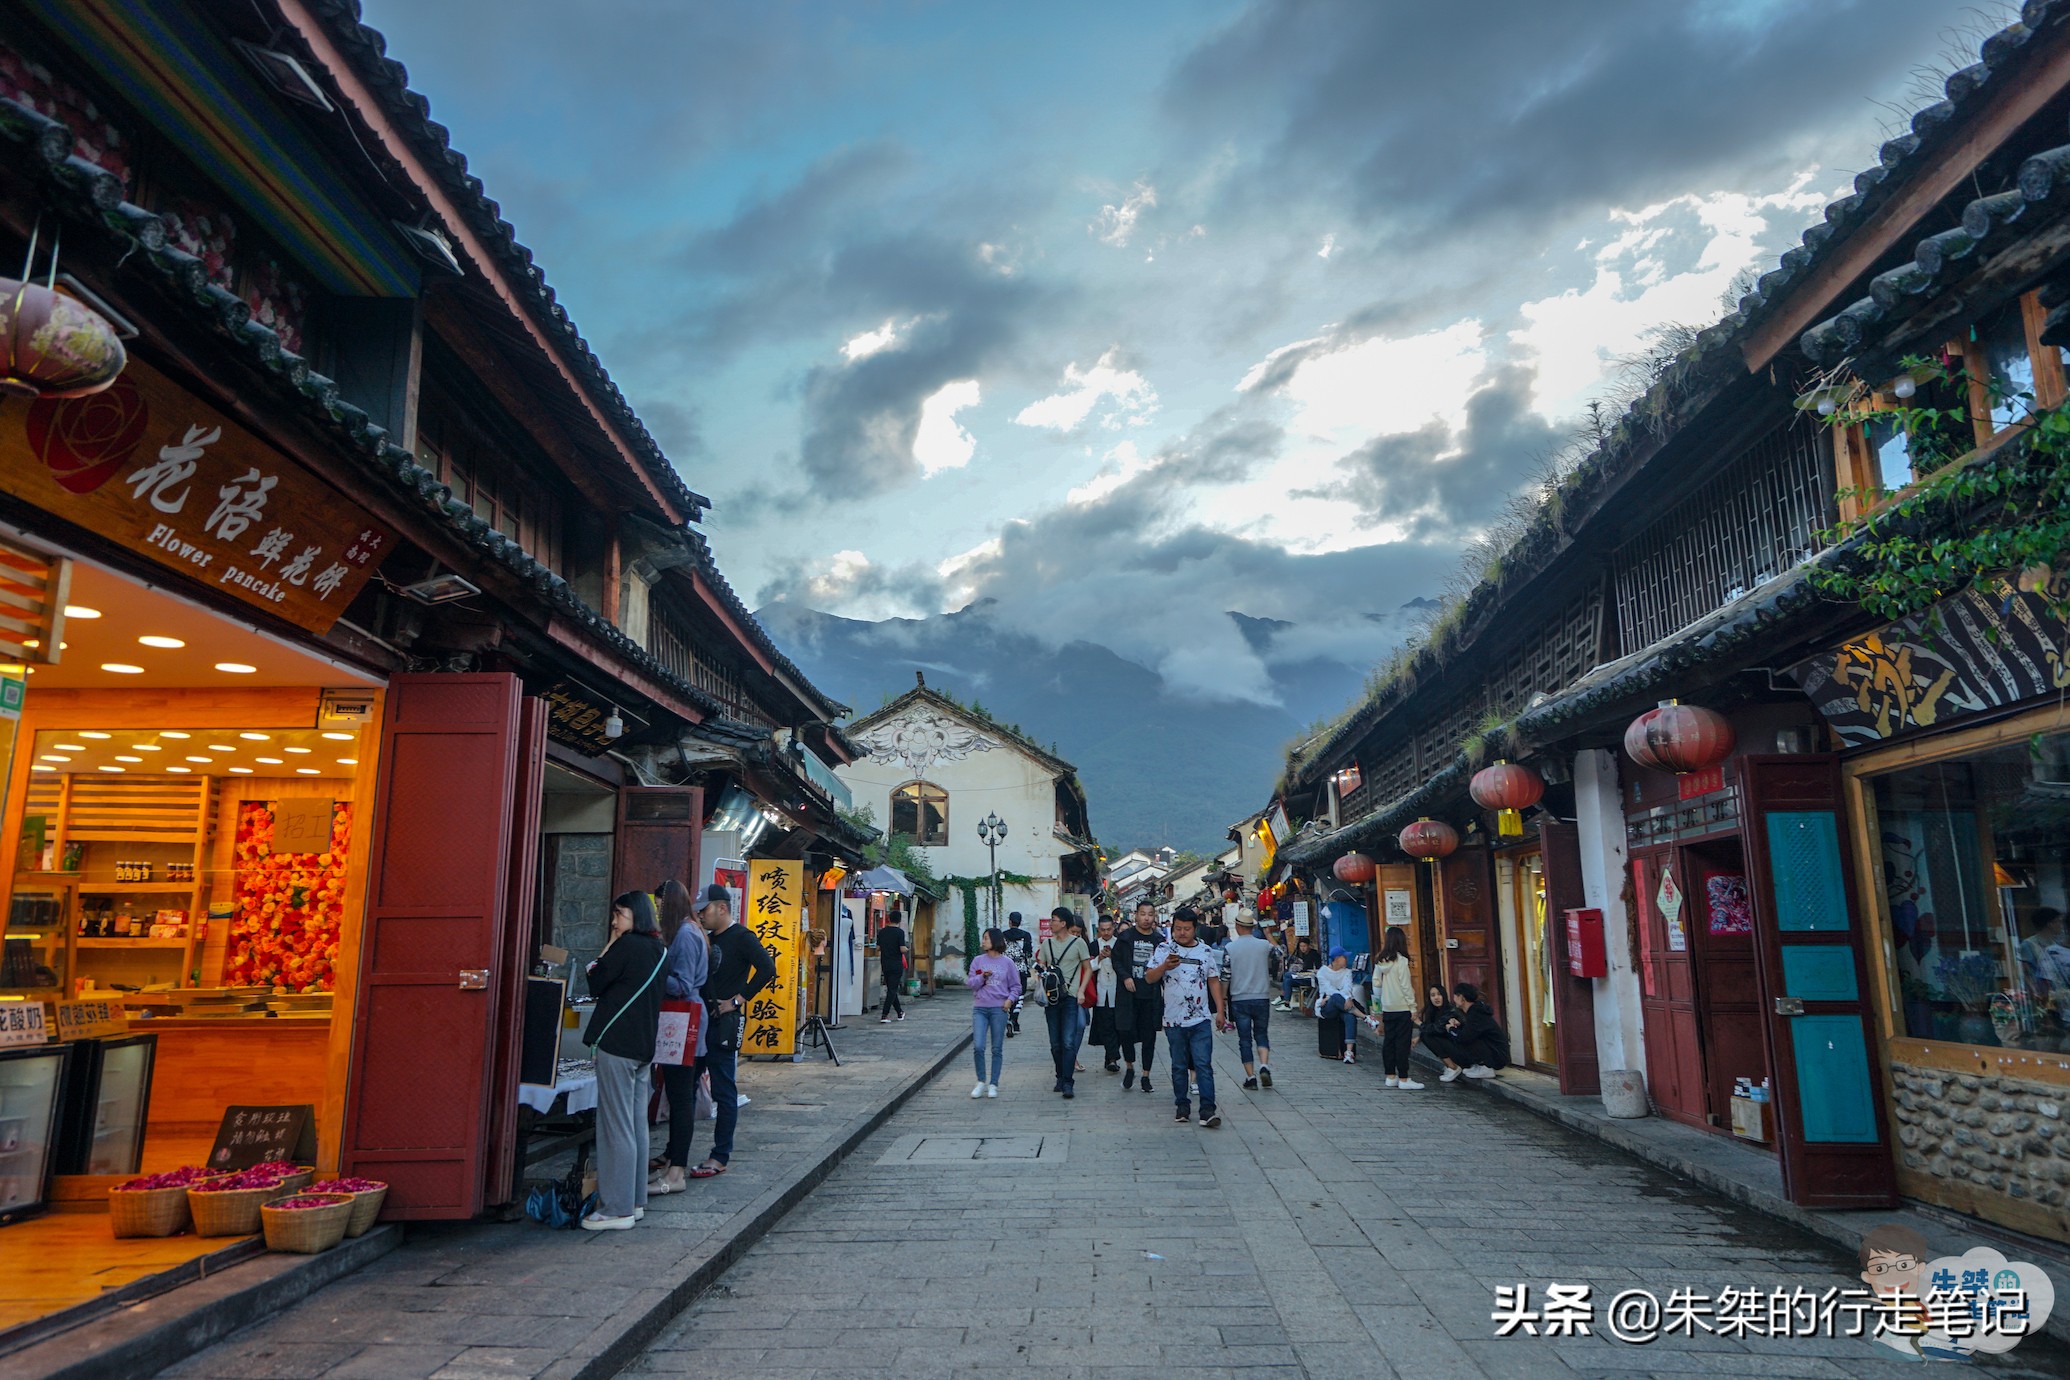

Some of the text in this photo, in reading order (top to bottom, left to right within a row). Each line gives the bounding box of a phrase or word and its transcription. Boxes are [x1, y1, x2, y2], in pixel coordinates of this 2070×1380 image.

[147, 523, 286, 603] Flower pancake
[250, 527, 348, 601] 鲜花饼
[282, 812, 327, 839] 招工
[736, 1016, 746, 1048] adidas
